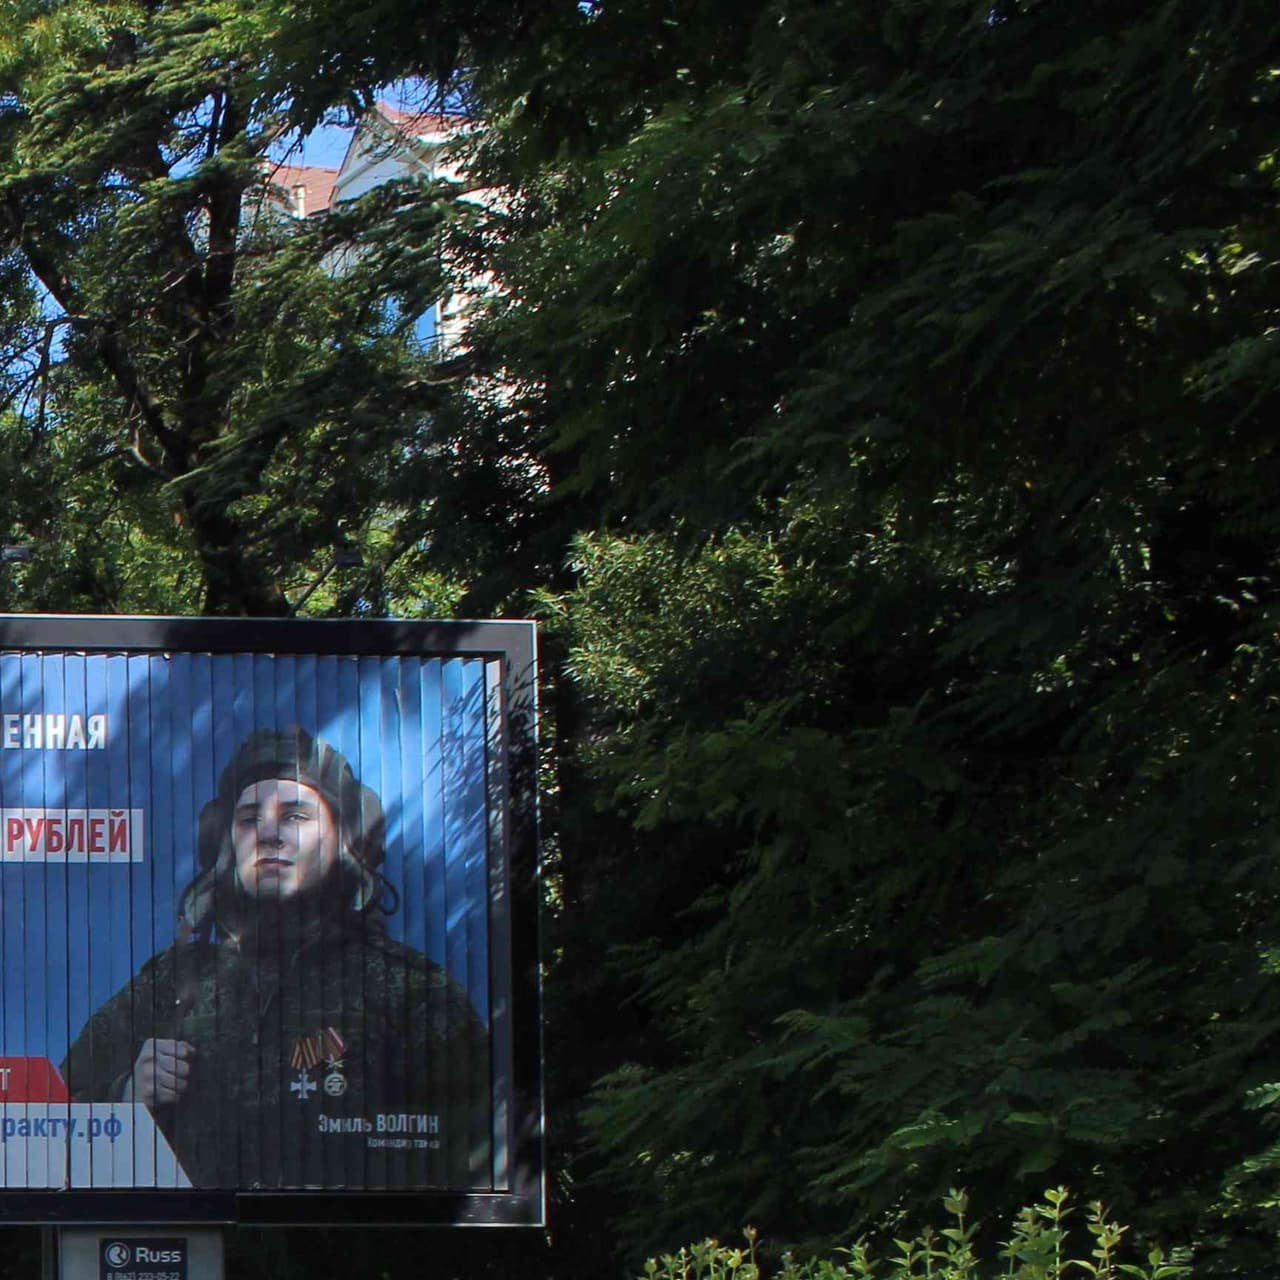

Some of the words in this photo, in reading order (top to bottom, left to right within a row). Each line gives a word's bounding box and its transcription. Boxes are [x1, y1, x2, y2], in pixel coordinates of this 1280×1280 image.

[7, 811, 128, 853] РУБЛЕЙ
[318, 1114, 372, 1133] Эмиль
[376, 1114, 440, 1134] ВОЛГИН
[135, 1247, 182, 1263] Russ
